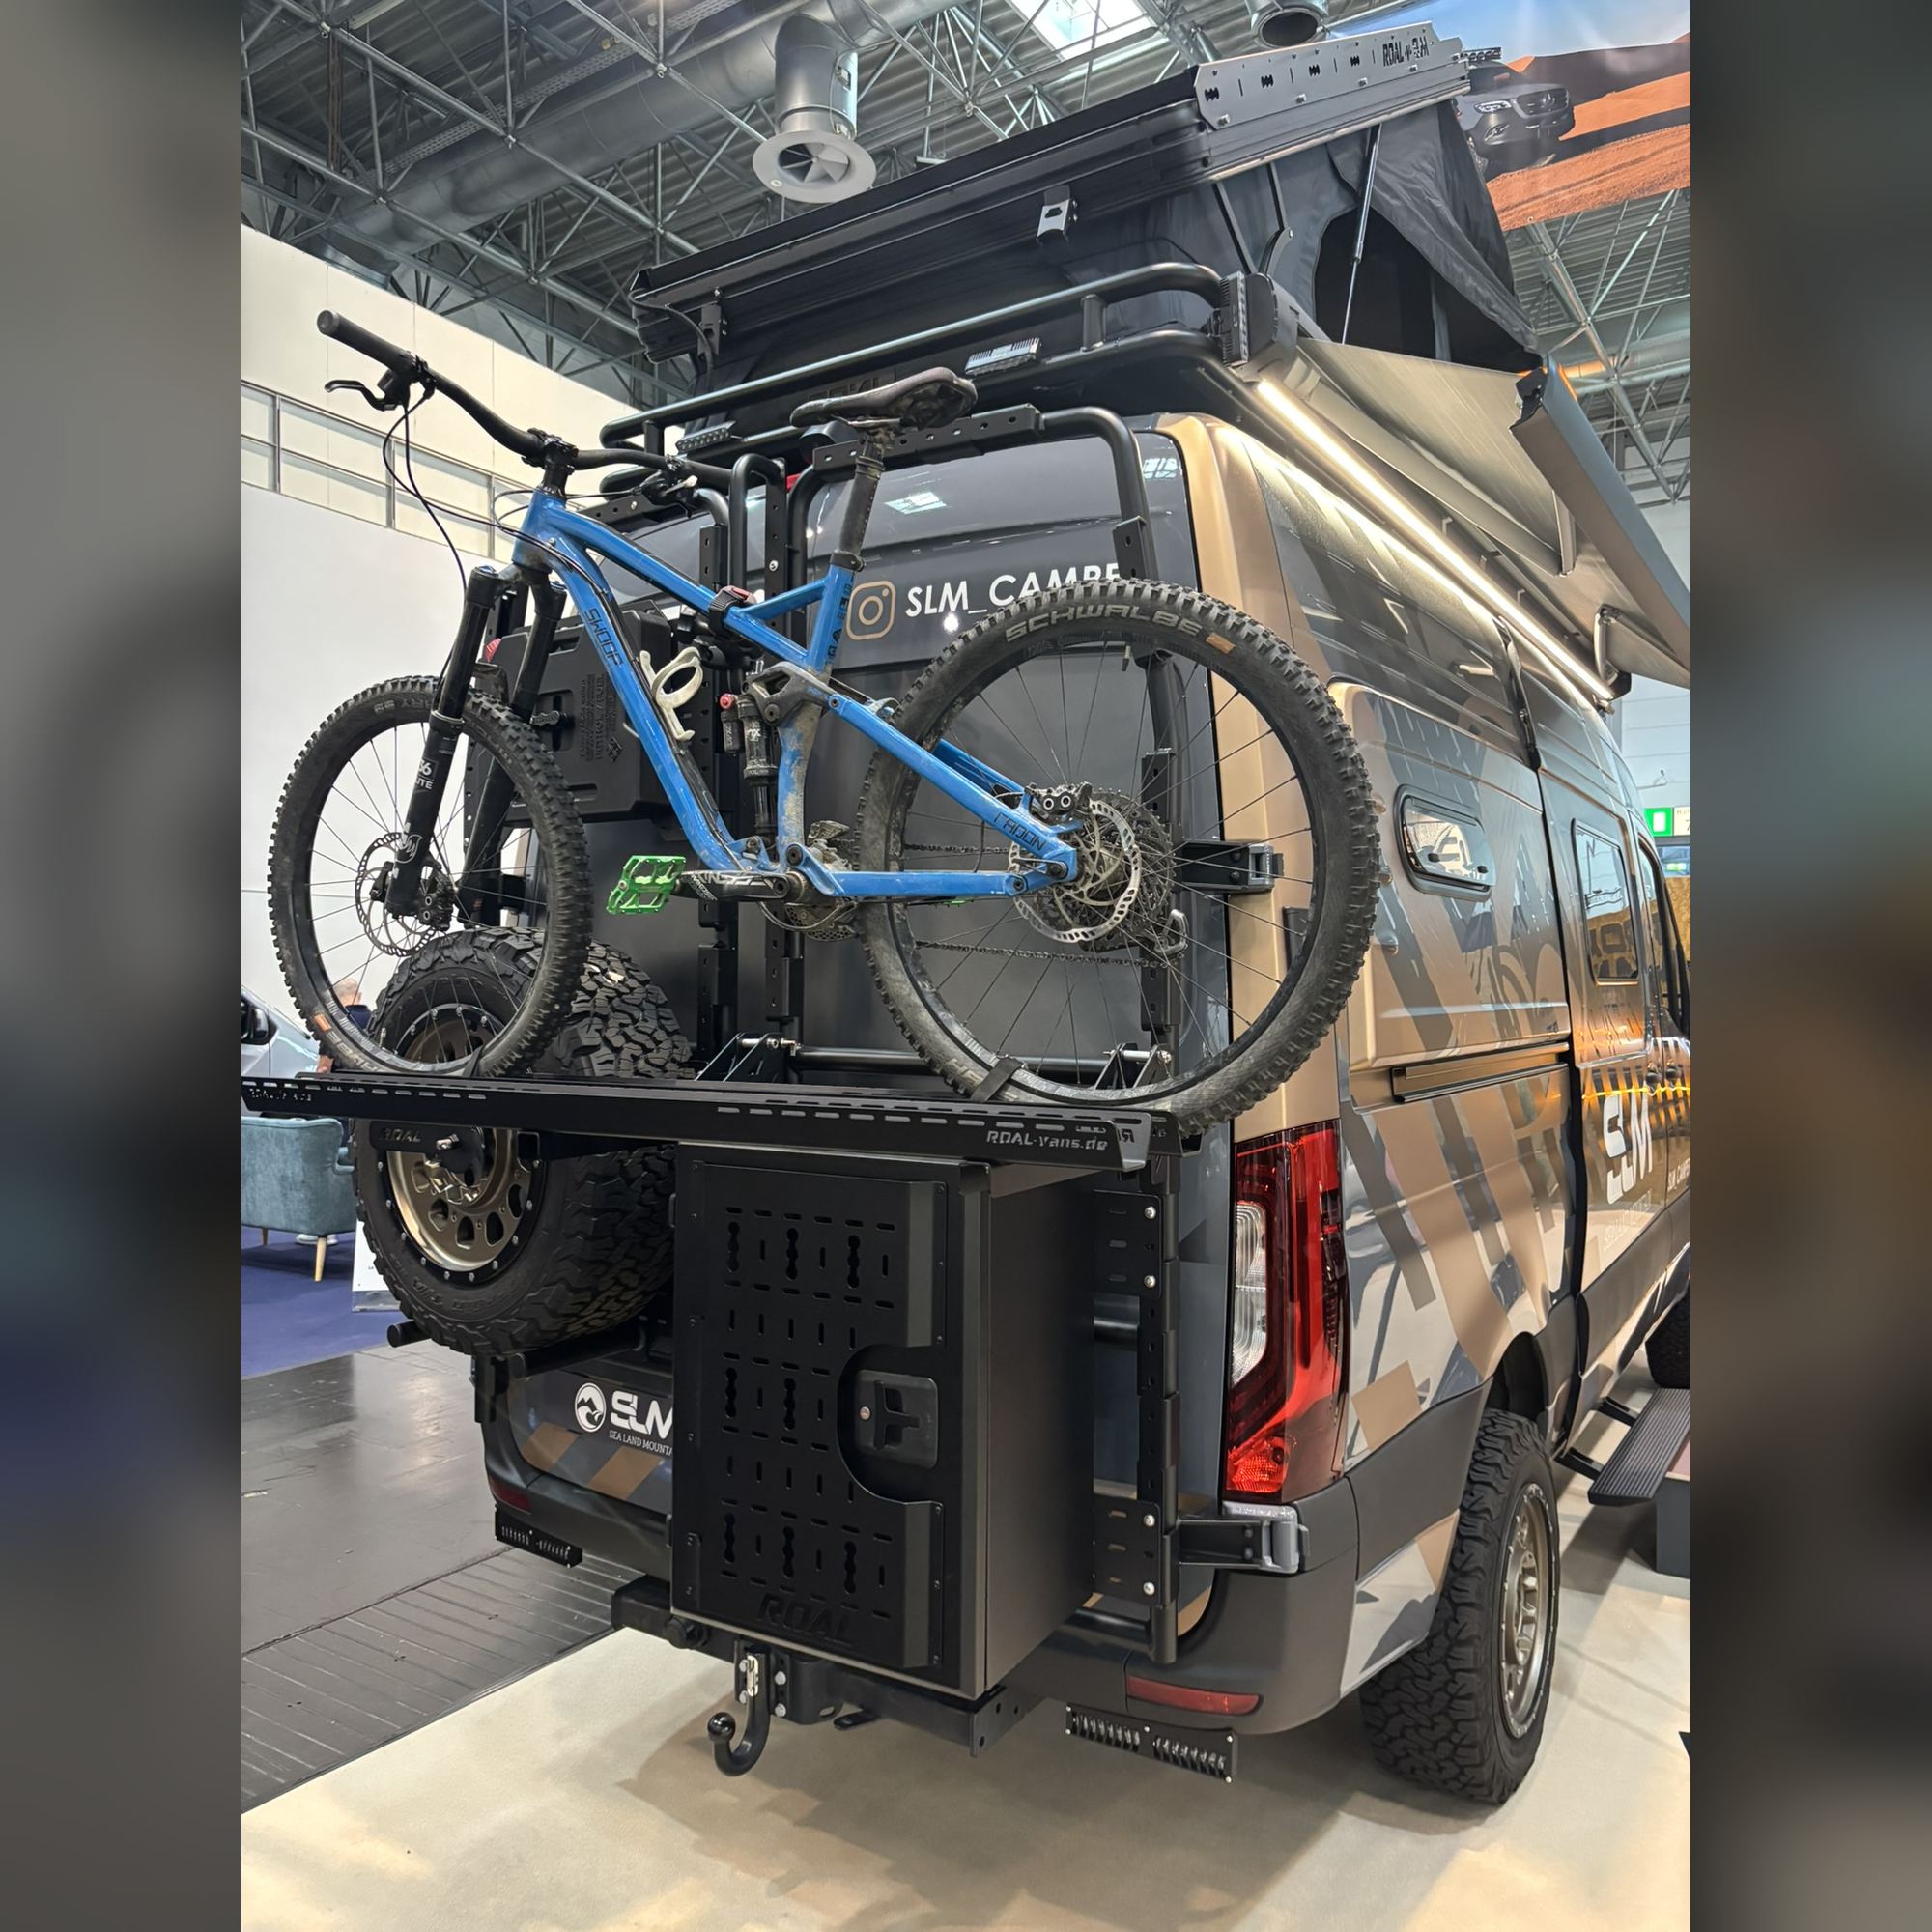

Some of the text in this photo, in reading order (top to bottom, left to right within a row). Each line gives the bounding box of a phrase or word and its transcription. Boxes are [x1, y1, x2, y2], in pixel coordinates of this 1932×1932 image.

[1005, 603, 1204, 643] SCHWALBE
[609, 1430, 622, 1442] SEA
[623, 1434, 642, 1448] LAND
